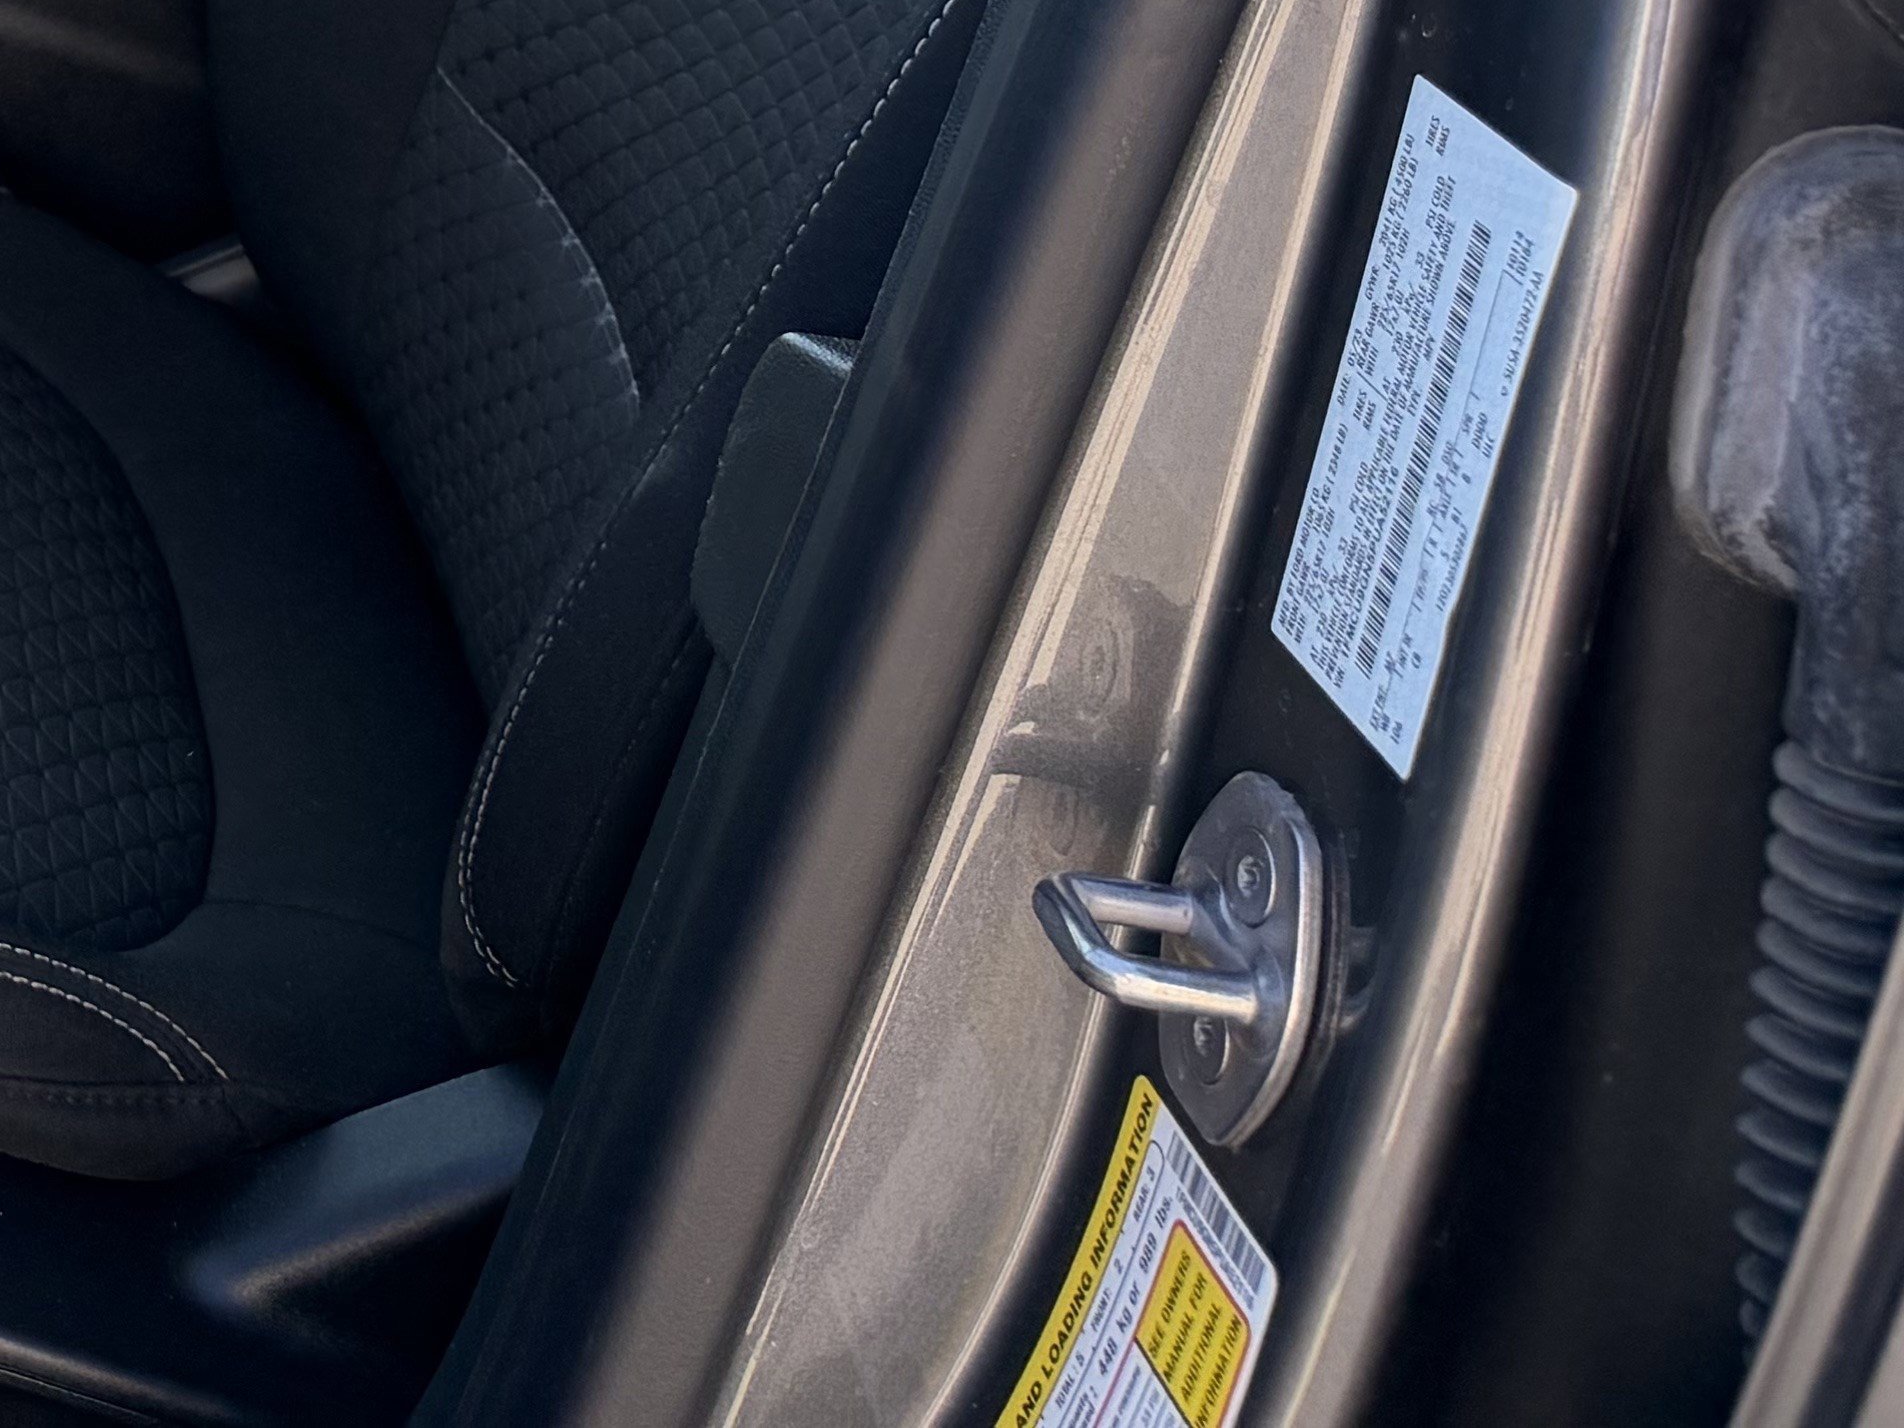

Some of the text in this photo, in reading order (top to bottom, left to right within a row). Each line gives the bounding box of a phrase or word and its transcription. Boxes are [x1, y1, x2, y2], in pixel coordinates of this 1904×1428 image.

[1016, 1380, 1043, 1428] AND
[1041, 1271, 1093, 1380] LOADING
[1090, 1093, 1154, 1270] INFORMATION
[1115, 1305, 1134, 1334] kg
[1128, 1280, 1141, 1307] or
[1163, 1271, 1208, 1385] MANUAL FOR
[1180, 1302, 1223, 1401] ADDITIONAL
[1194, 1315, 1243, 1428] INFORMATION
